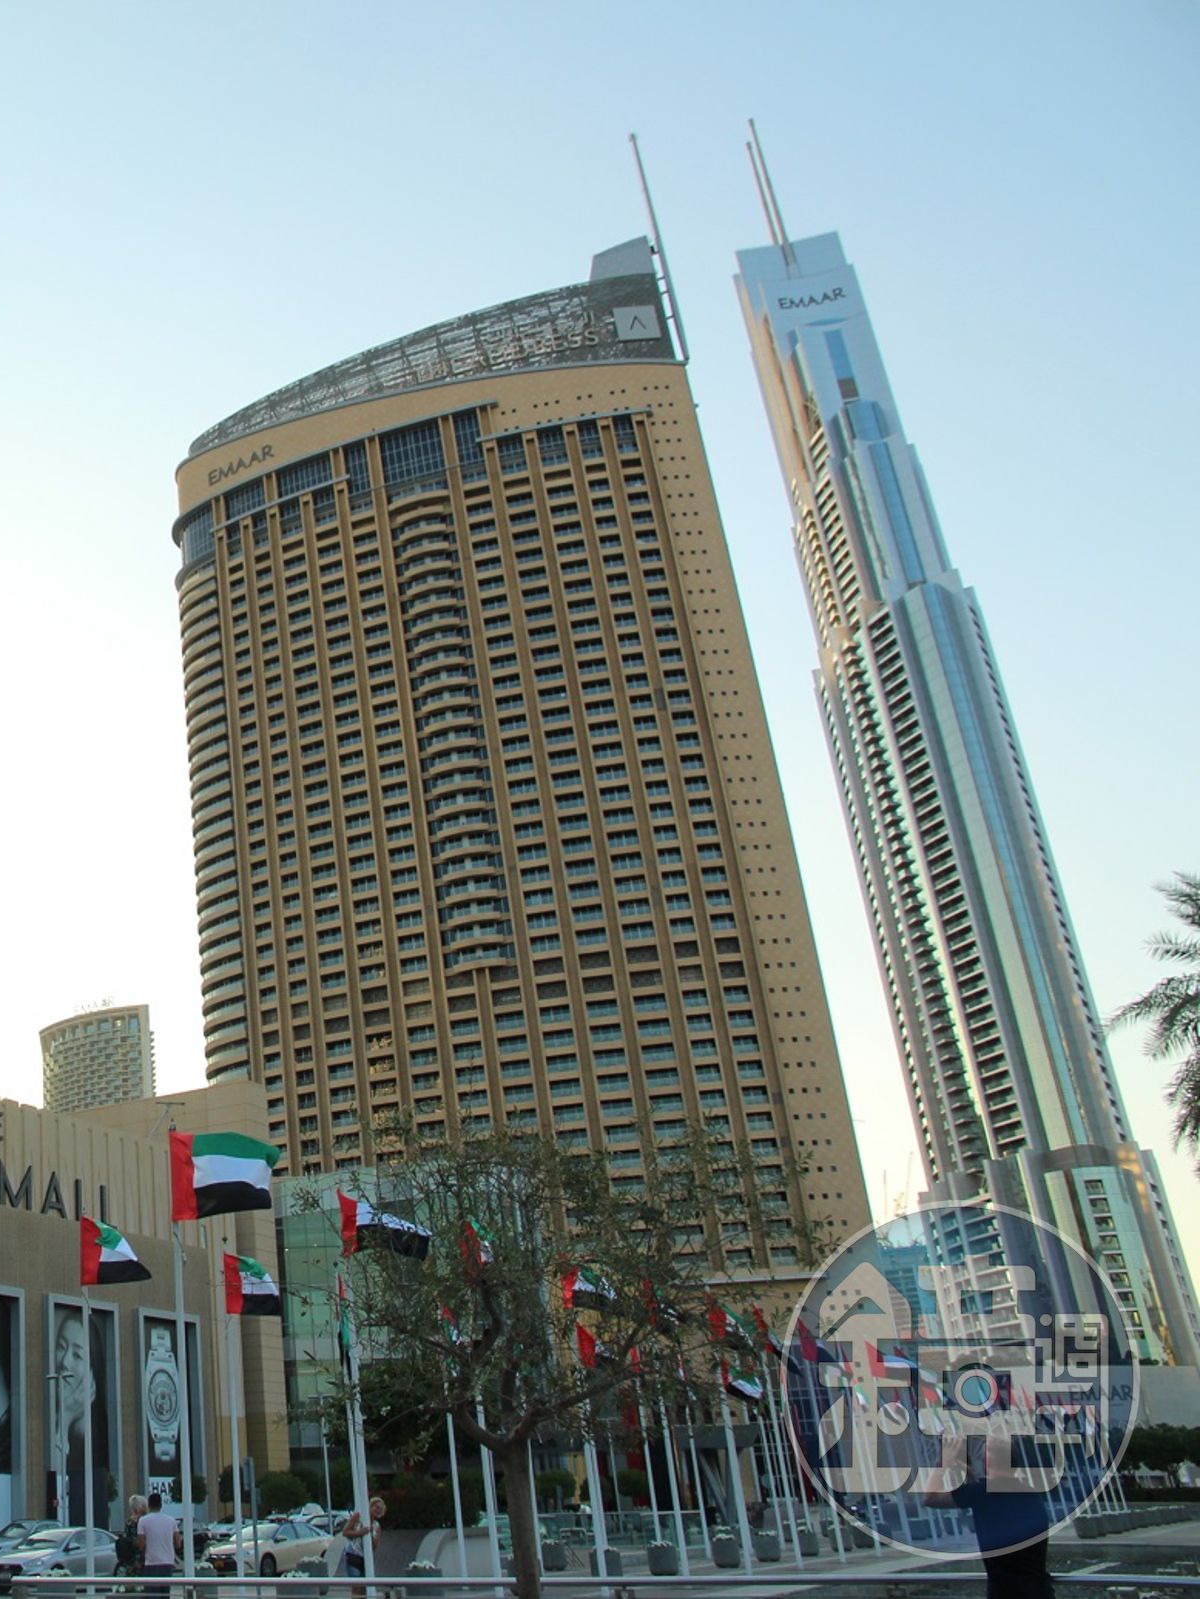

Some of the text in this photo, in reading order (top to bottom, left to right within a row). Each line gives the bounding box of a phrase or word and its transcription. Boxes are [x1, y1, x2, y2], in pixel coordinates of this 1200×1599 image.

[778, 287, 847, 309] EMAAR
[207, 444, 275, 486] EMAAR
[1067, 1384, 1136, 1402] EMAAR
